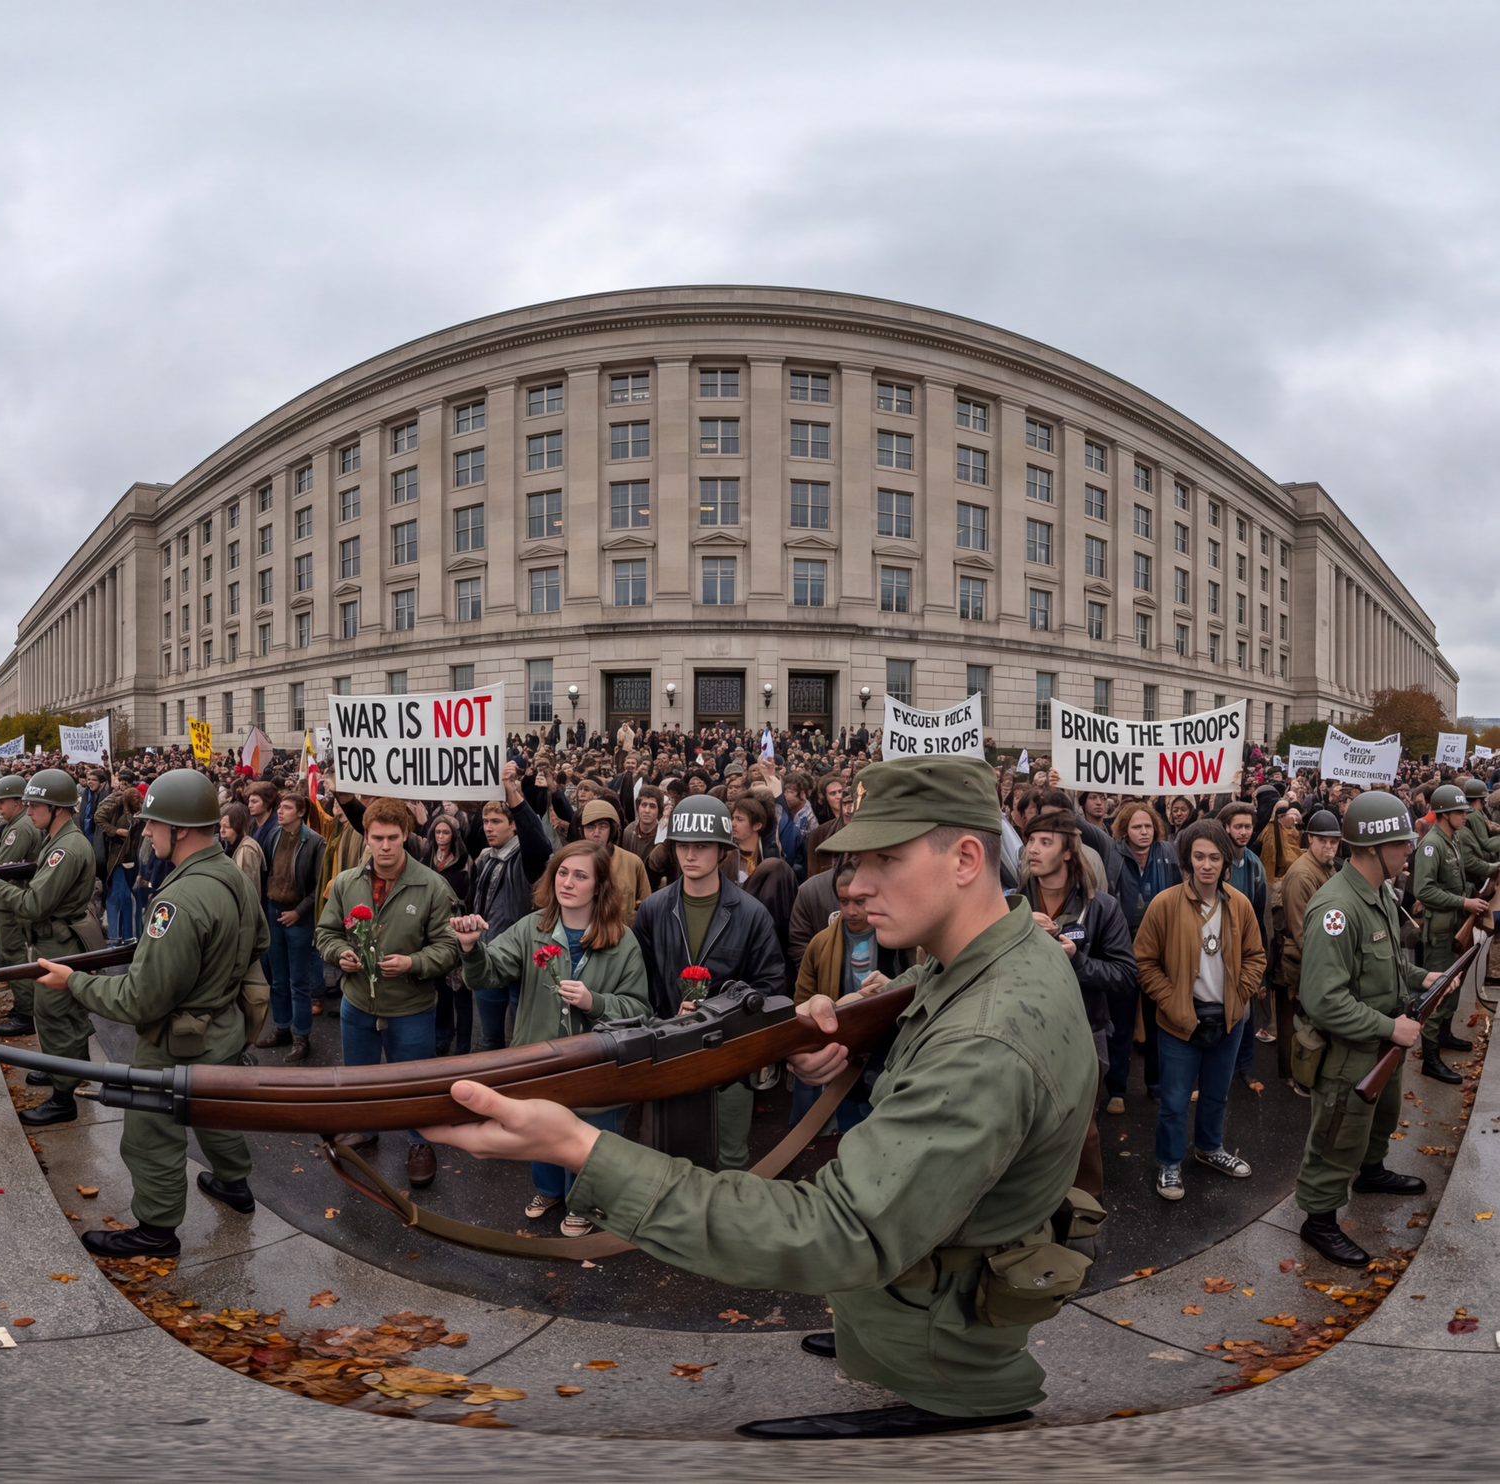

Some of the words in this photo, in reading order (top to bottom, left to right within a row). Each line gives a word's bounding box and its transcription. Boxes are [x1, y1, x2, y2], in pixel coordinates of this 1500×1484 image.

[336, 702, 389, 739] WAR
[397, 701, 423, 740] IS
[434, 694, 492, 739] NOT
[1061, 709, 1119, 744] BRING
[1126, 723, 1164, 746] THE
[1170, 711, 1239, 746] TROOPS
[889, 730, 917, 754] FOR
[337, 746, 378, 787] FOR
[386, 744, 500, 788] CHILDREN
[1075, 748, 1145, 786] HOME
[1158, 747, 1225, 787] NOW
